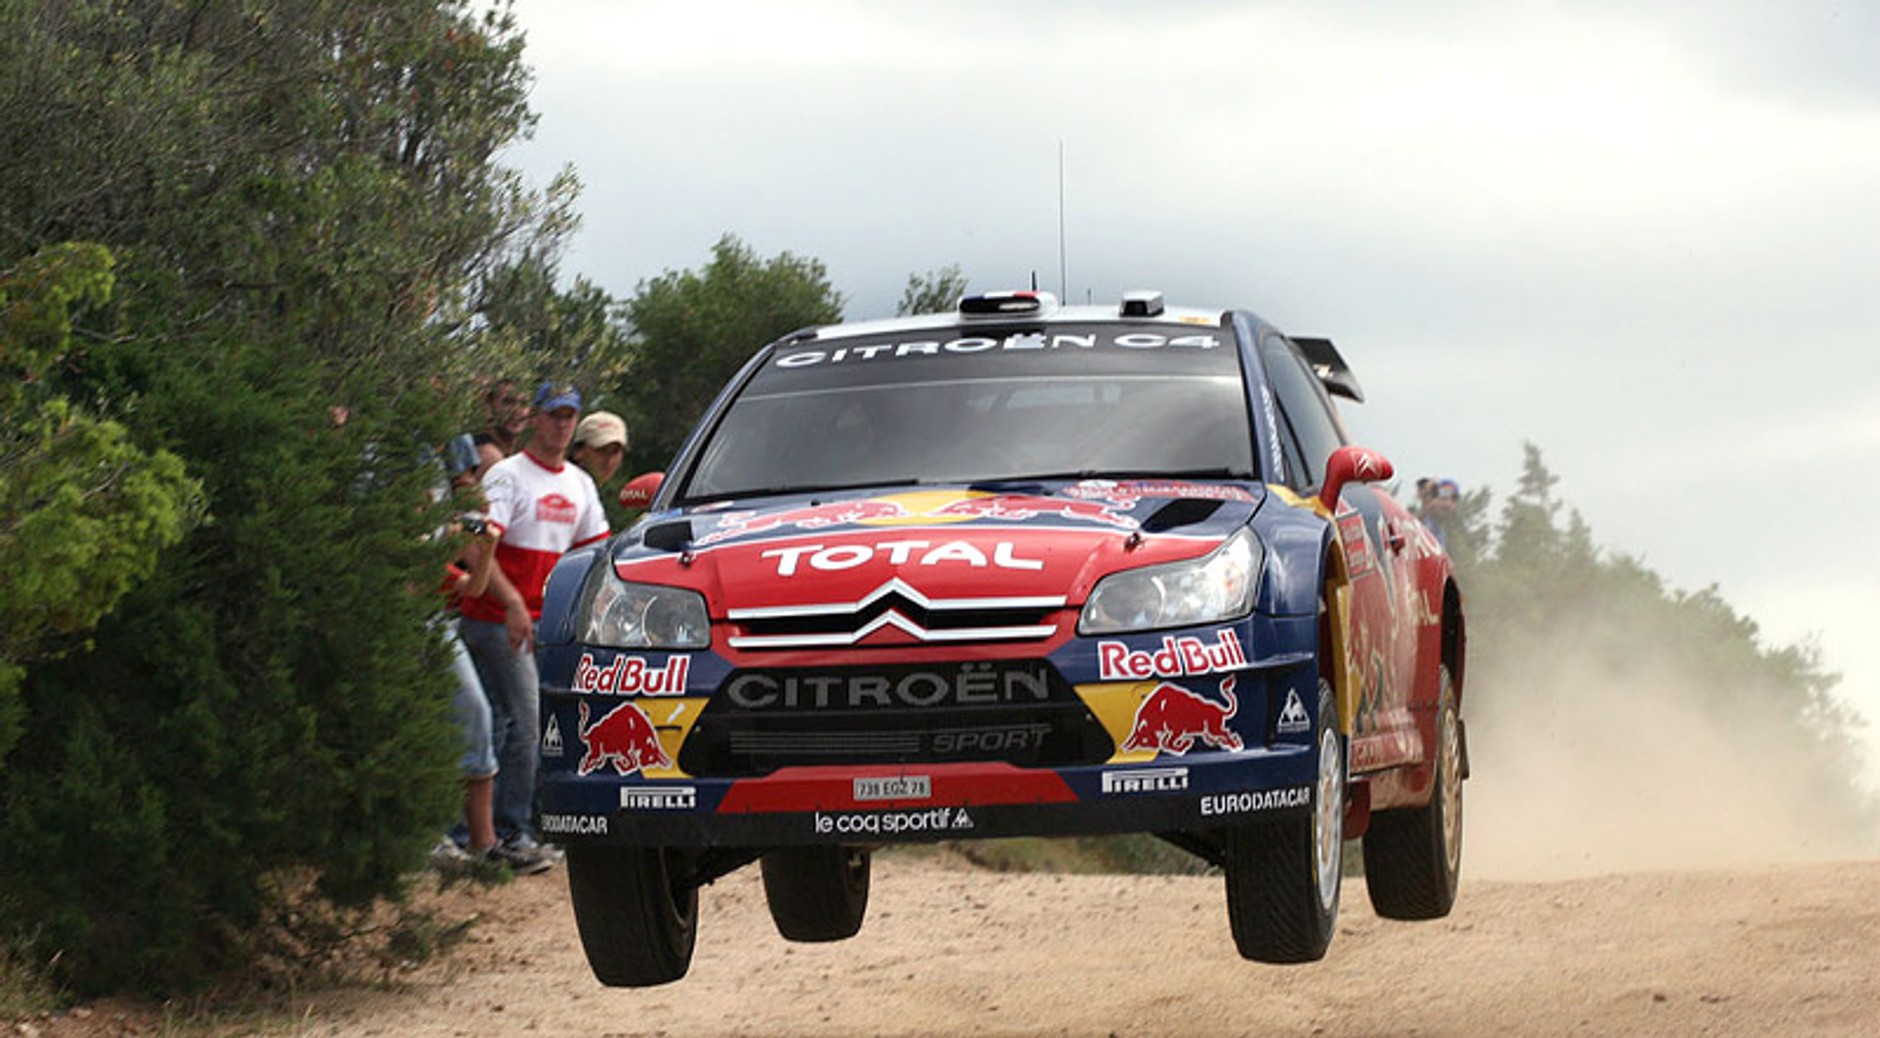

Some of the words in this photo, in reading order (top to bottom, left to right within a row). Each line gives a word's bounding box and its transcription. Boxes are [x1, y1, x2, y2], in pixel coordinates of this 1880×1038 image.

[1114, 333, 1221, 349] C4
[760, 540, 1044, 576] TOTAL
[1098, 636, 1183, 680] Red
[1177, 628, 1247, 675] Bull
[571, 653, 625, 694] Red
[615, 655, 691, 695] Bull
[727, 662, 1049, 708] CITROËN
[932, 724, 1051, 752] SPORT
[860, 783, 880, 796] 738
[911, 780, 925, 793] 78
[1102, 767, 1189, 793] PIRELLI
[620, 786, 697, 809] PIRELLI
[1200, 787, 1310, 816] EURODATACAR
[815, 811, 834, 833] le
[837, 814, 880, 834] coq
[882, 808, 951, 833] sportif
